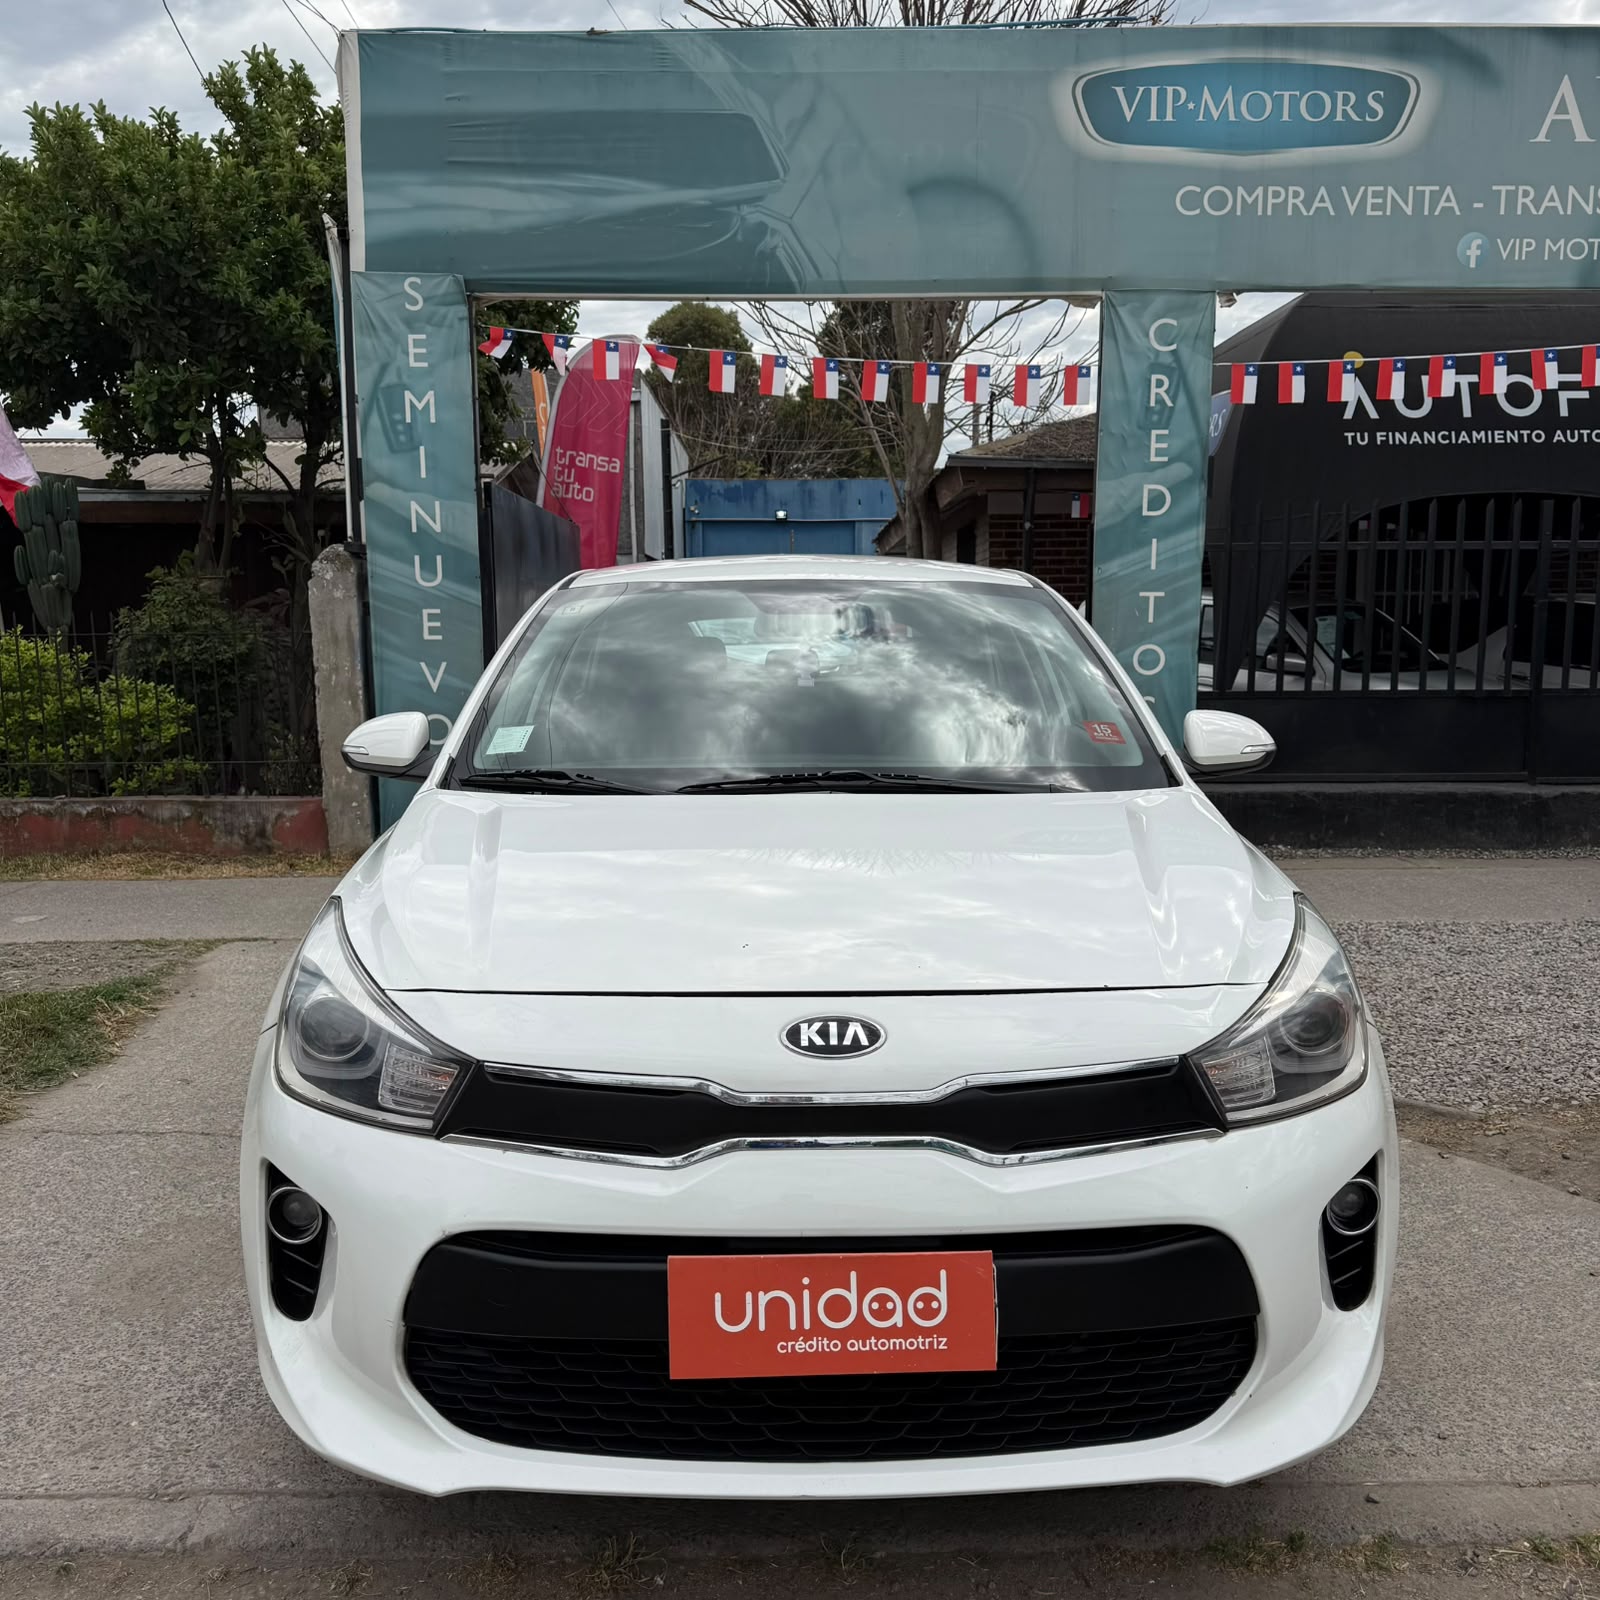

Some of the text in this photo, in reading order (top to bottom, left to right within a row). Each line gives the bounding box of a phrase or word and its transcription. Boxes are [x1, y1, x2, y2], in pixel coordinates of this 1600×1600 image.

[1112, 84, 1385, 123] VIP MOTORS
[1529, 74, 1600, 143] A
[1496, 238, 1536, 261] VIP
[1344, 431, 1369, 446] TU
[1376, 429, 1546, 445] FINANCIAMIENTO
[553, 463, 576, 482] tu
[555, 445, 621, 474] transa
[550, 480, 594, 503] auto
[1132, 318, 1178, 704] CREDITO
[798, 1021, 870, 1047] KIA
[713, 1268, 948, 1334] unidad
[776, 1333, 948, 1354] crédito automotriz
